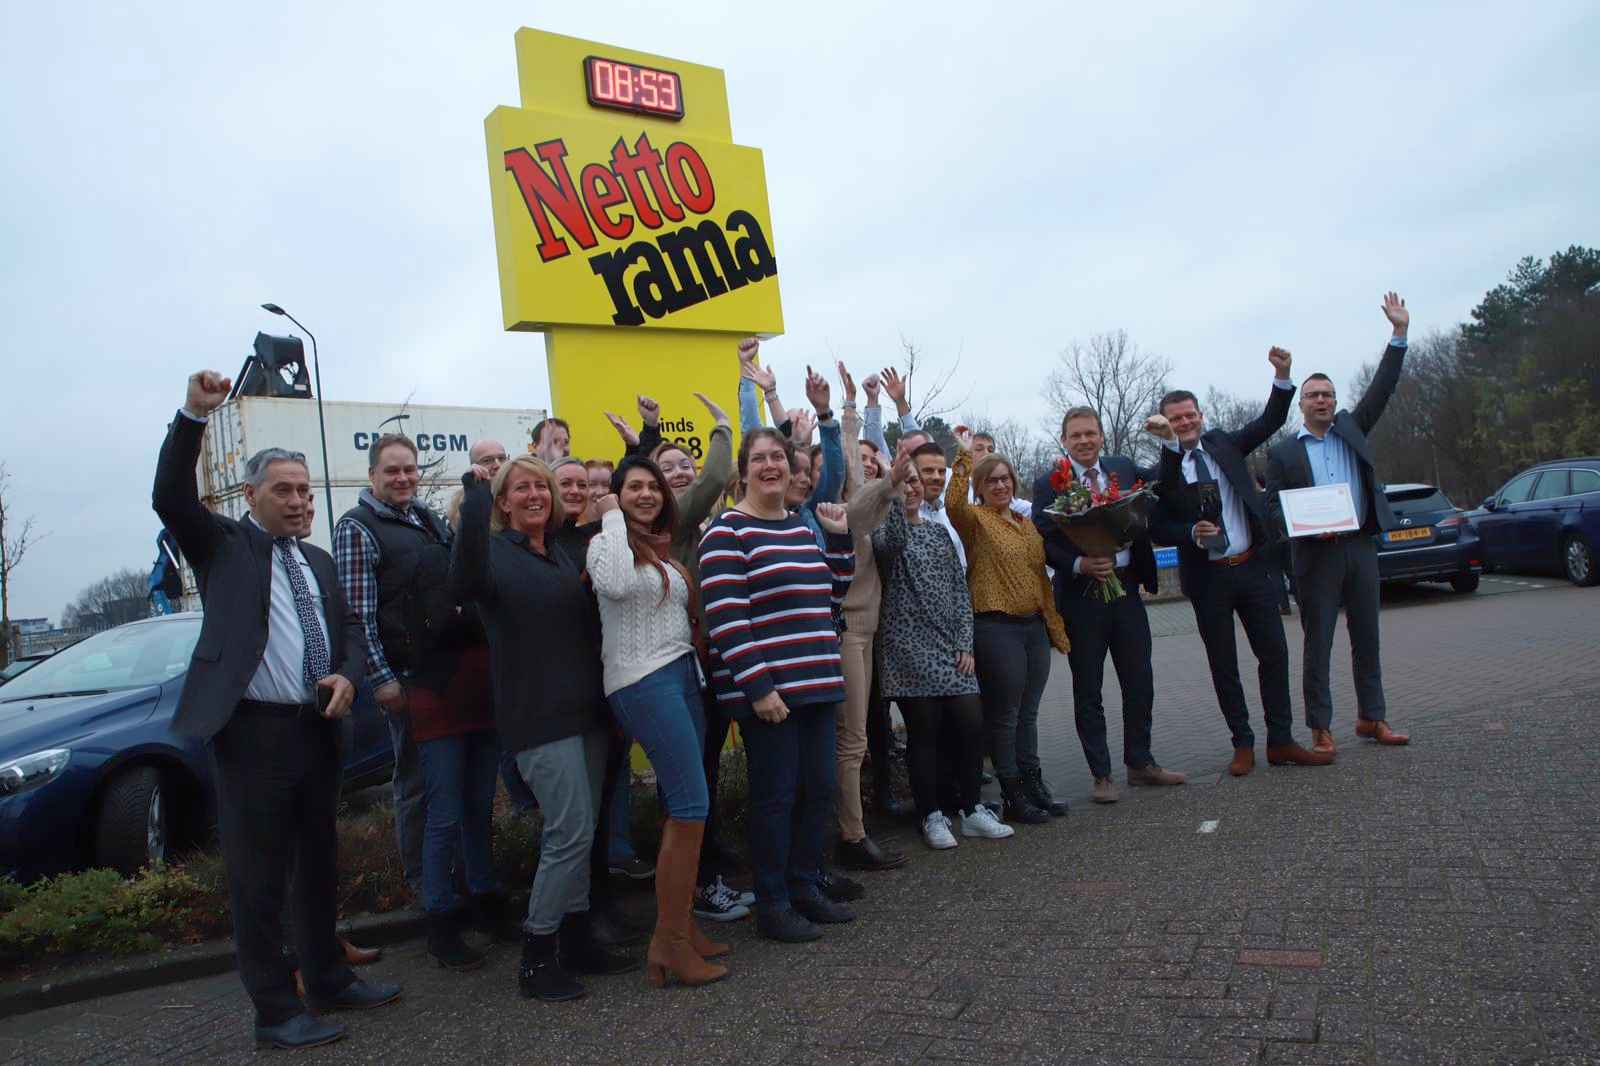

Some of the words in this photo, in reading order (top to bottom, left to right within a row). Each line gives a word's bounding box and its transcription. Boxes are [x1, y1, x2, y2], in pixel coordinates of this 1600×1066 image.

[595, 60, 677, 111] 08:53
[504, 131, 715, 263] Netto
[588, 209, 778, 326] rama
[416, 433, 468, 452] CGM
[657, 416, 694, 432] inds
